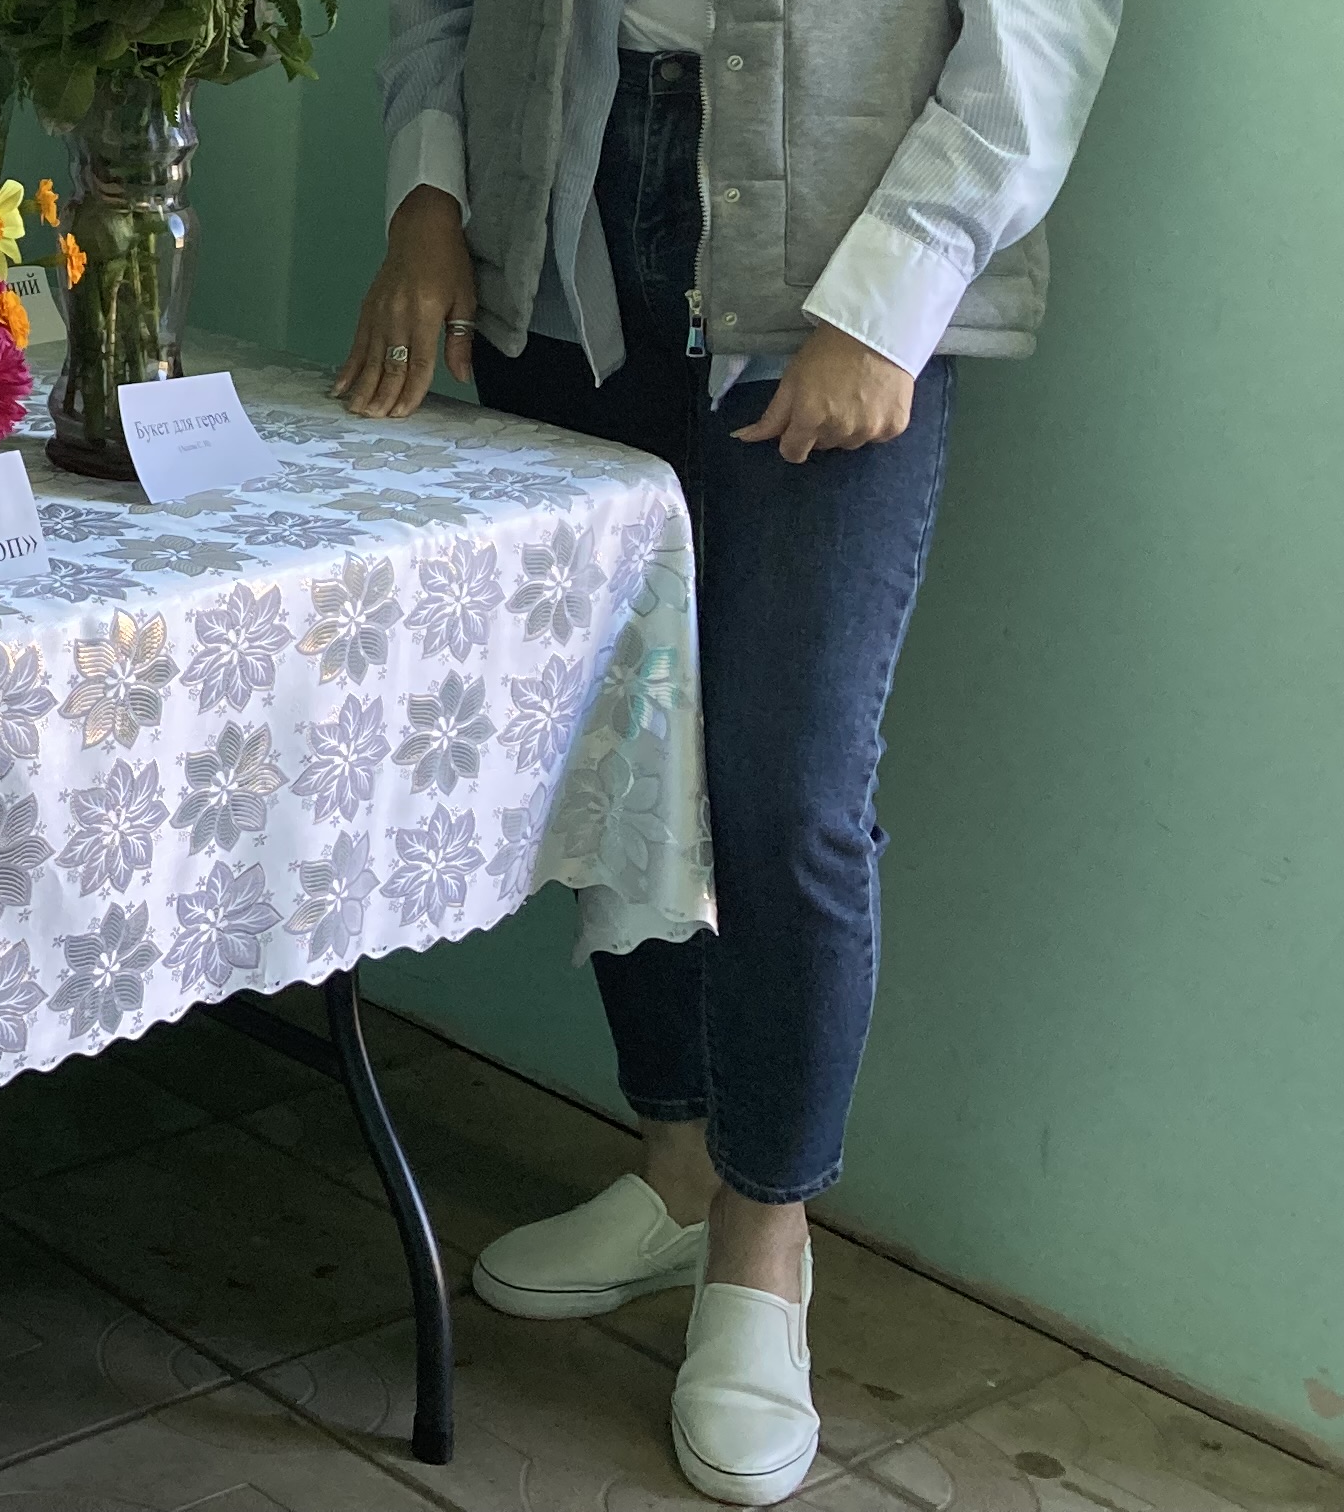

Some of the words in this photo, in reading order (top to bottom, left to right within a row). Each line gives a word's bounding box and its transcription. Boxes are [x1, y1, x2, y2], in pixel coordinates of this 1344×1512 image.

[134, 420, 170, 443] Букет
[173, 417, 195, 435] для
[196, 411, 231, 431] героя
